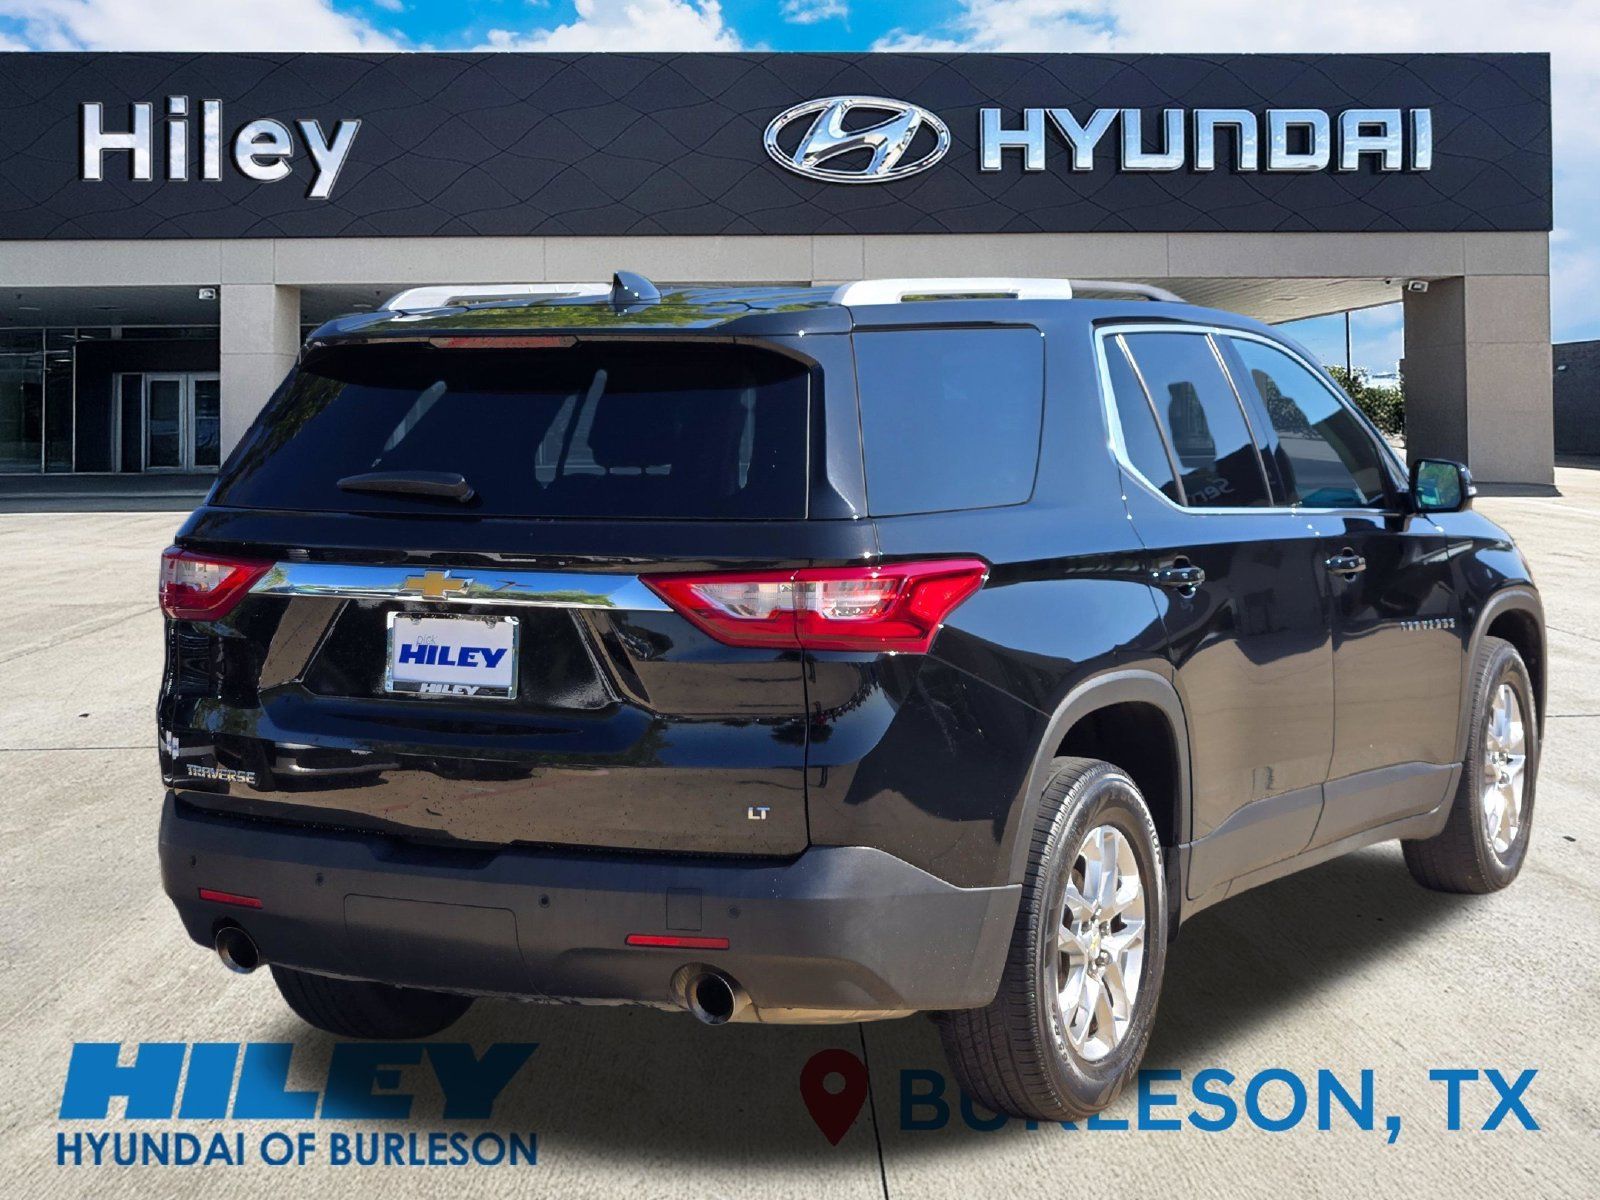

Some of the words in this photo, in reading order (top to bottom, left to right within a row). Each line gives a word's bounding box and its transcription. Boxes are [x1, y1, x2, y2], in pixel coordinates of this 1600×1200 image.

[81, 95, 361, 200] Hiley
[979, 107, 1433, 172] HYUNDAI
[398, 643, 507, 668] HILEY
[419, 683, 481, 696] HILEY
[186, 763, 256, 785] TRAVERSE
[748, 807, 770, 820] LT
